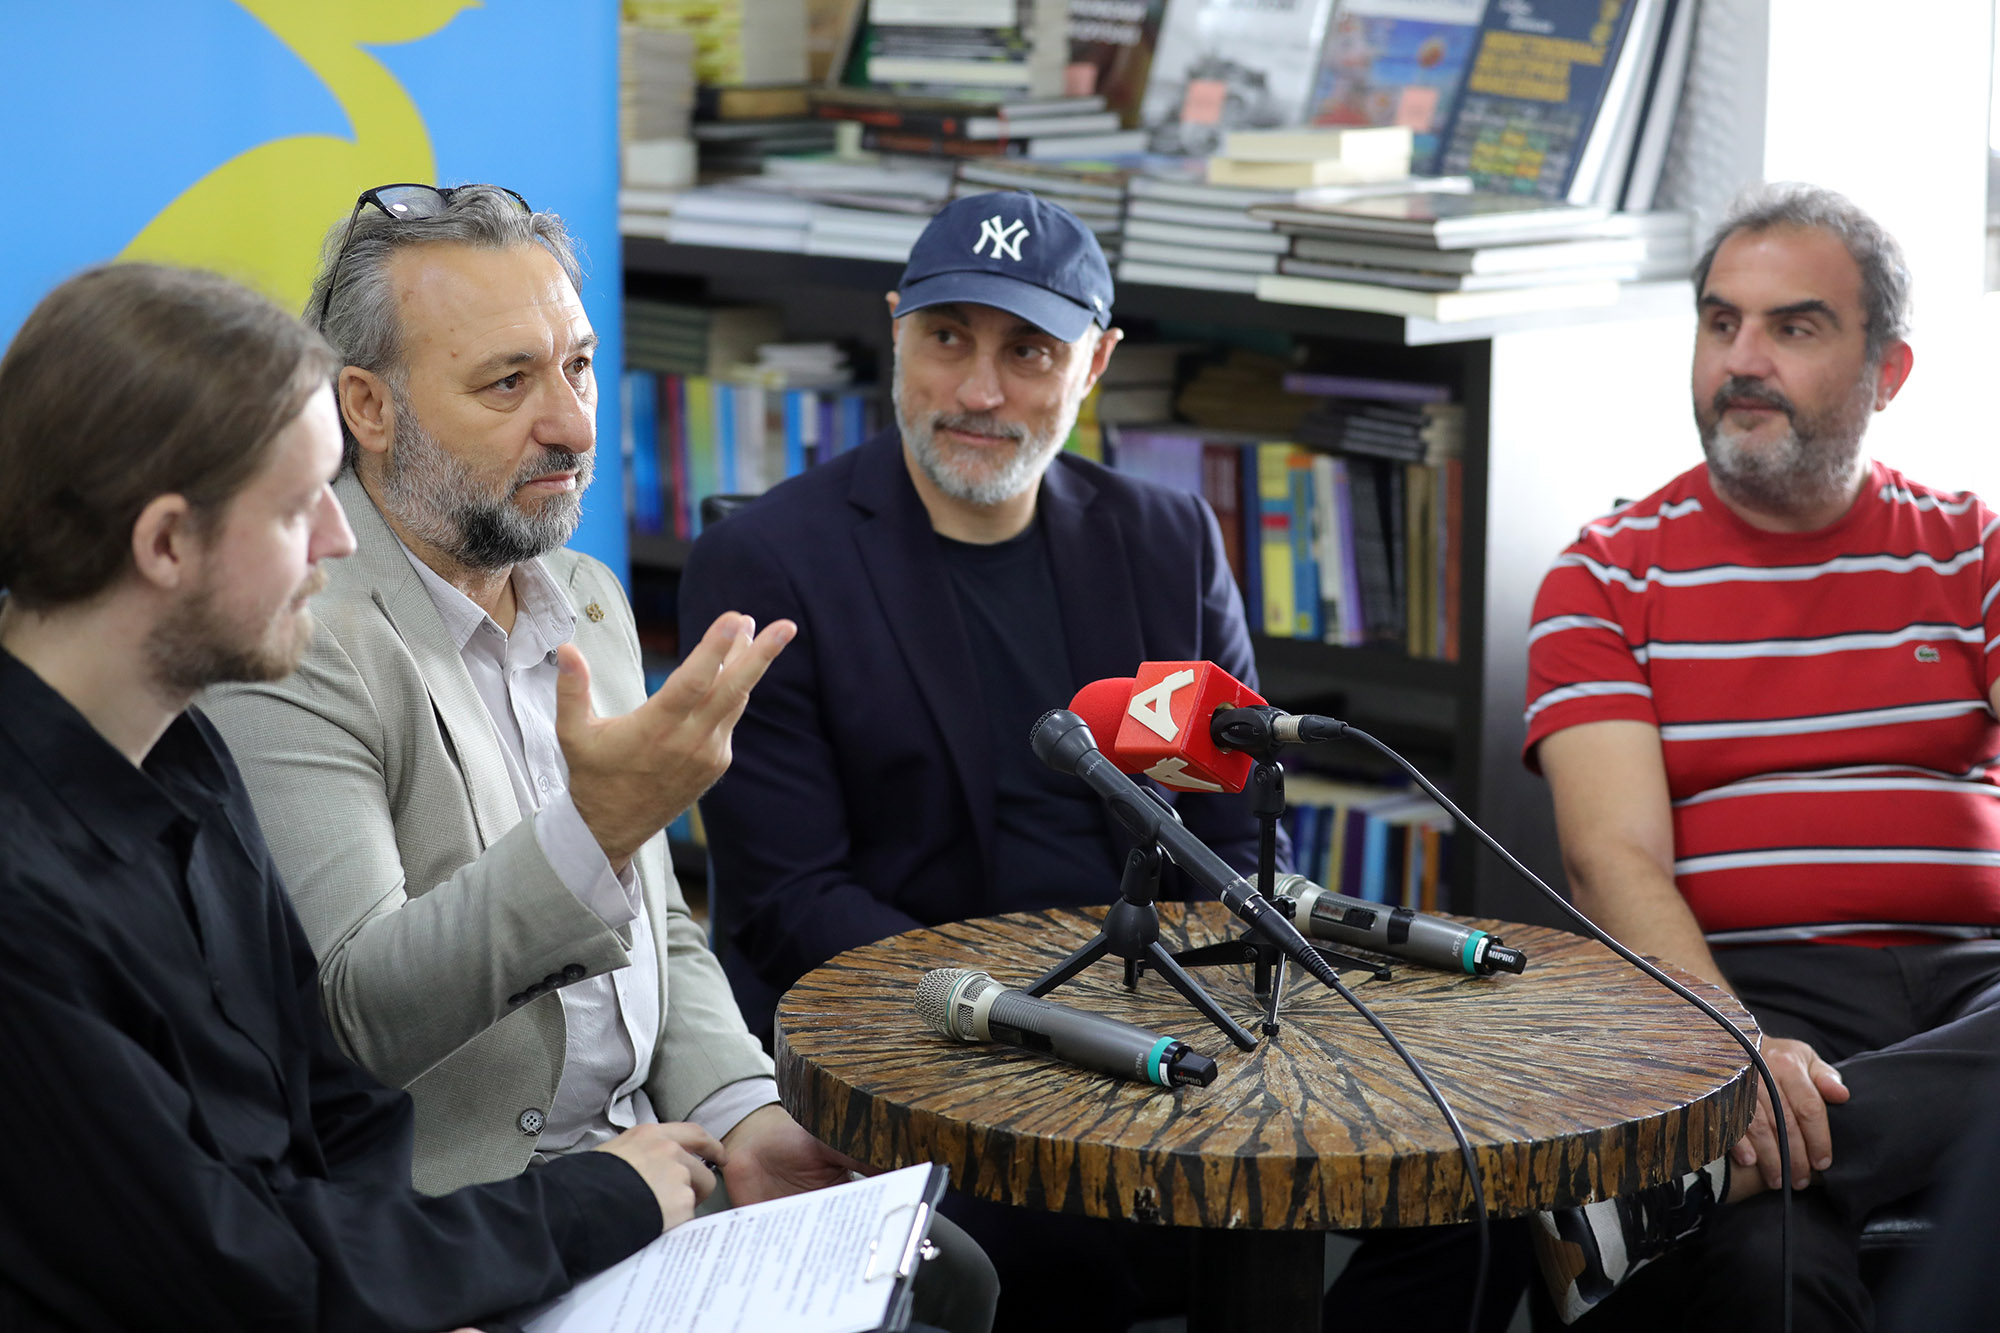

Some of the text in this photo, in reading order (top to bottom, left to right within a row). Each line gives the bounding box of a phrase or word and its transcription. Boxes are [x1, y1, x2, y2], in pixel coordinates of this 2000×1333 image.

[972, 214, 1030, 262] NY
[1086, 758, 1104, 776] SONY
[1487, 948, 1515, 964] MIPRO
